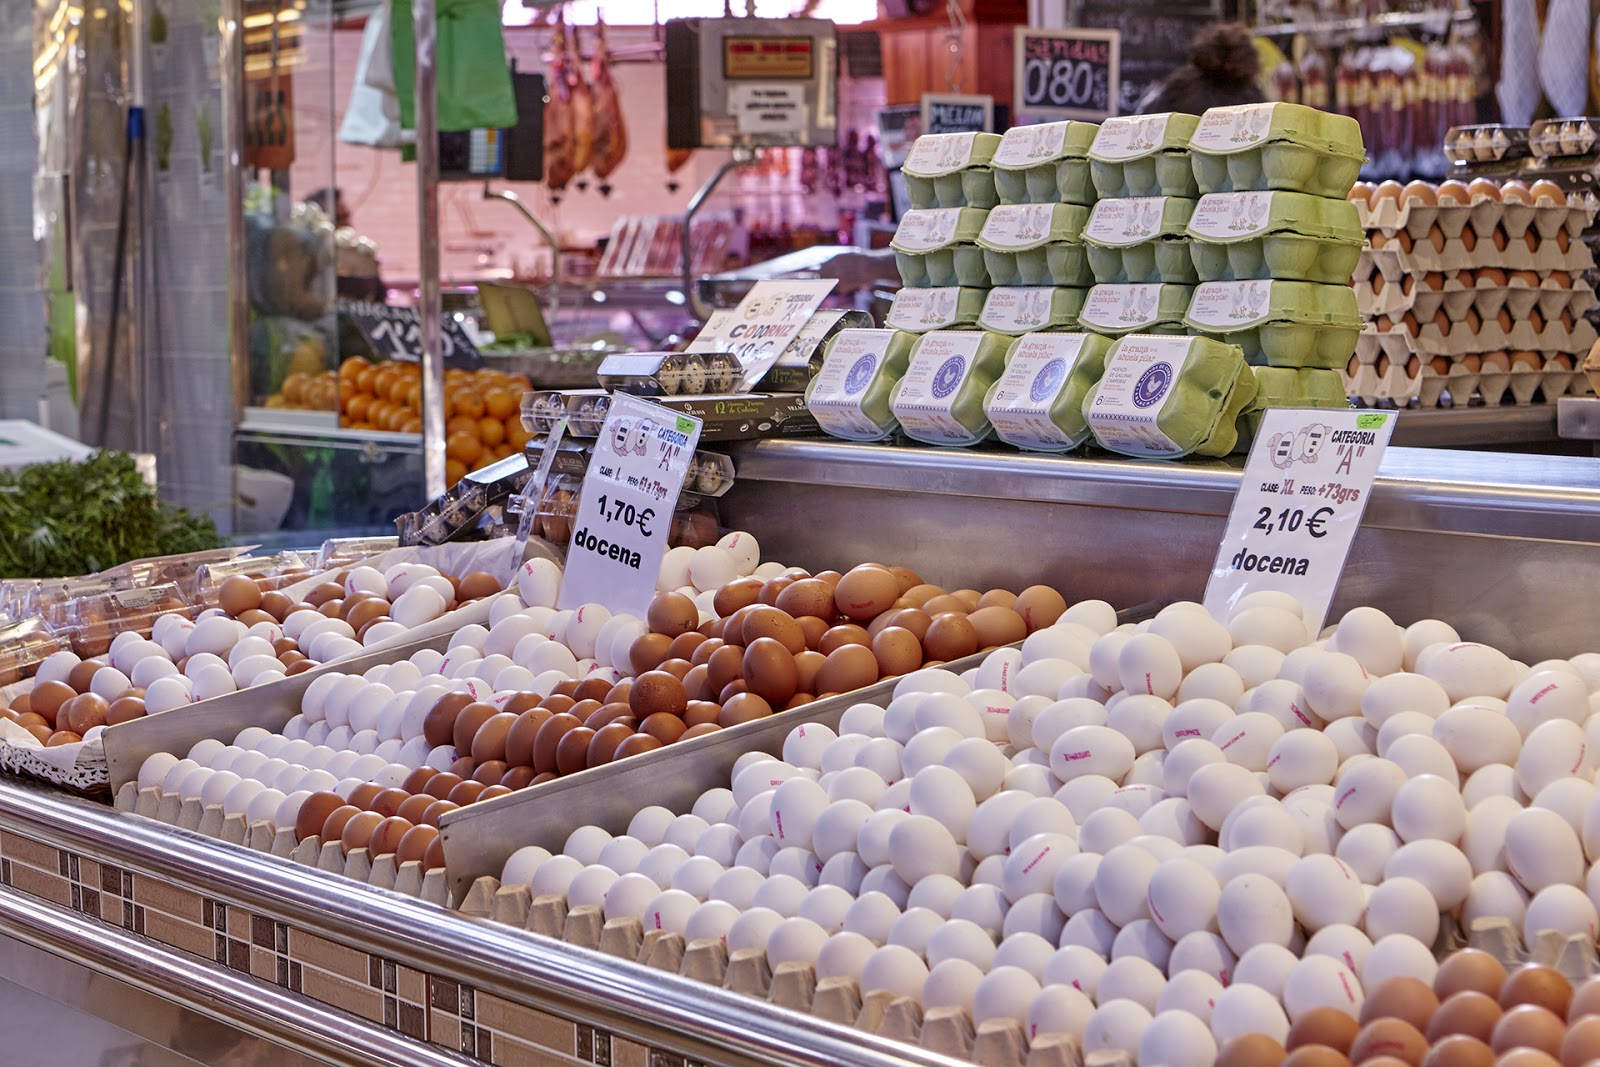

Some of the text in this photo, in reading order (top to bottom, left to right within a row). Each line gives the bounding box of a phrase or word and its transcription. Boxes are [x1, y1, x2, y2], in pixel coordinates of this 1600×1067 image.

[729, 324, 796, 339] CODORNIZ
[1117, 354, 1138, 362] abuela
[1128, 345, 1149, 354] granja
[900, 387, 908, 397] 6
[996, 390, 1005, 401] 6
[1095, 395, 1104, 406] 6
[714, 402, 725, 415] 12
[657, 427, 689, 448] CATEGORIA
[1331, 430, 1376, 446] CATEGORIA
[658, 443, 681, 471] "A"
[1335, 445, 1366, 475] "A"
[1260, 479, 1361, 505] CLASE: XL PESO: +73grs
[598, 494, 656, 537] 1,70€
[1253, 506, 1335, 539] 2,10€
[574, 527, 642, 570] docena
[1231, 547, 1310, 576] docena
